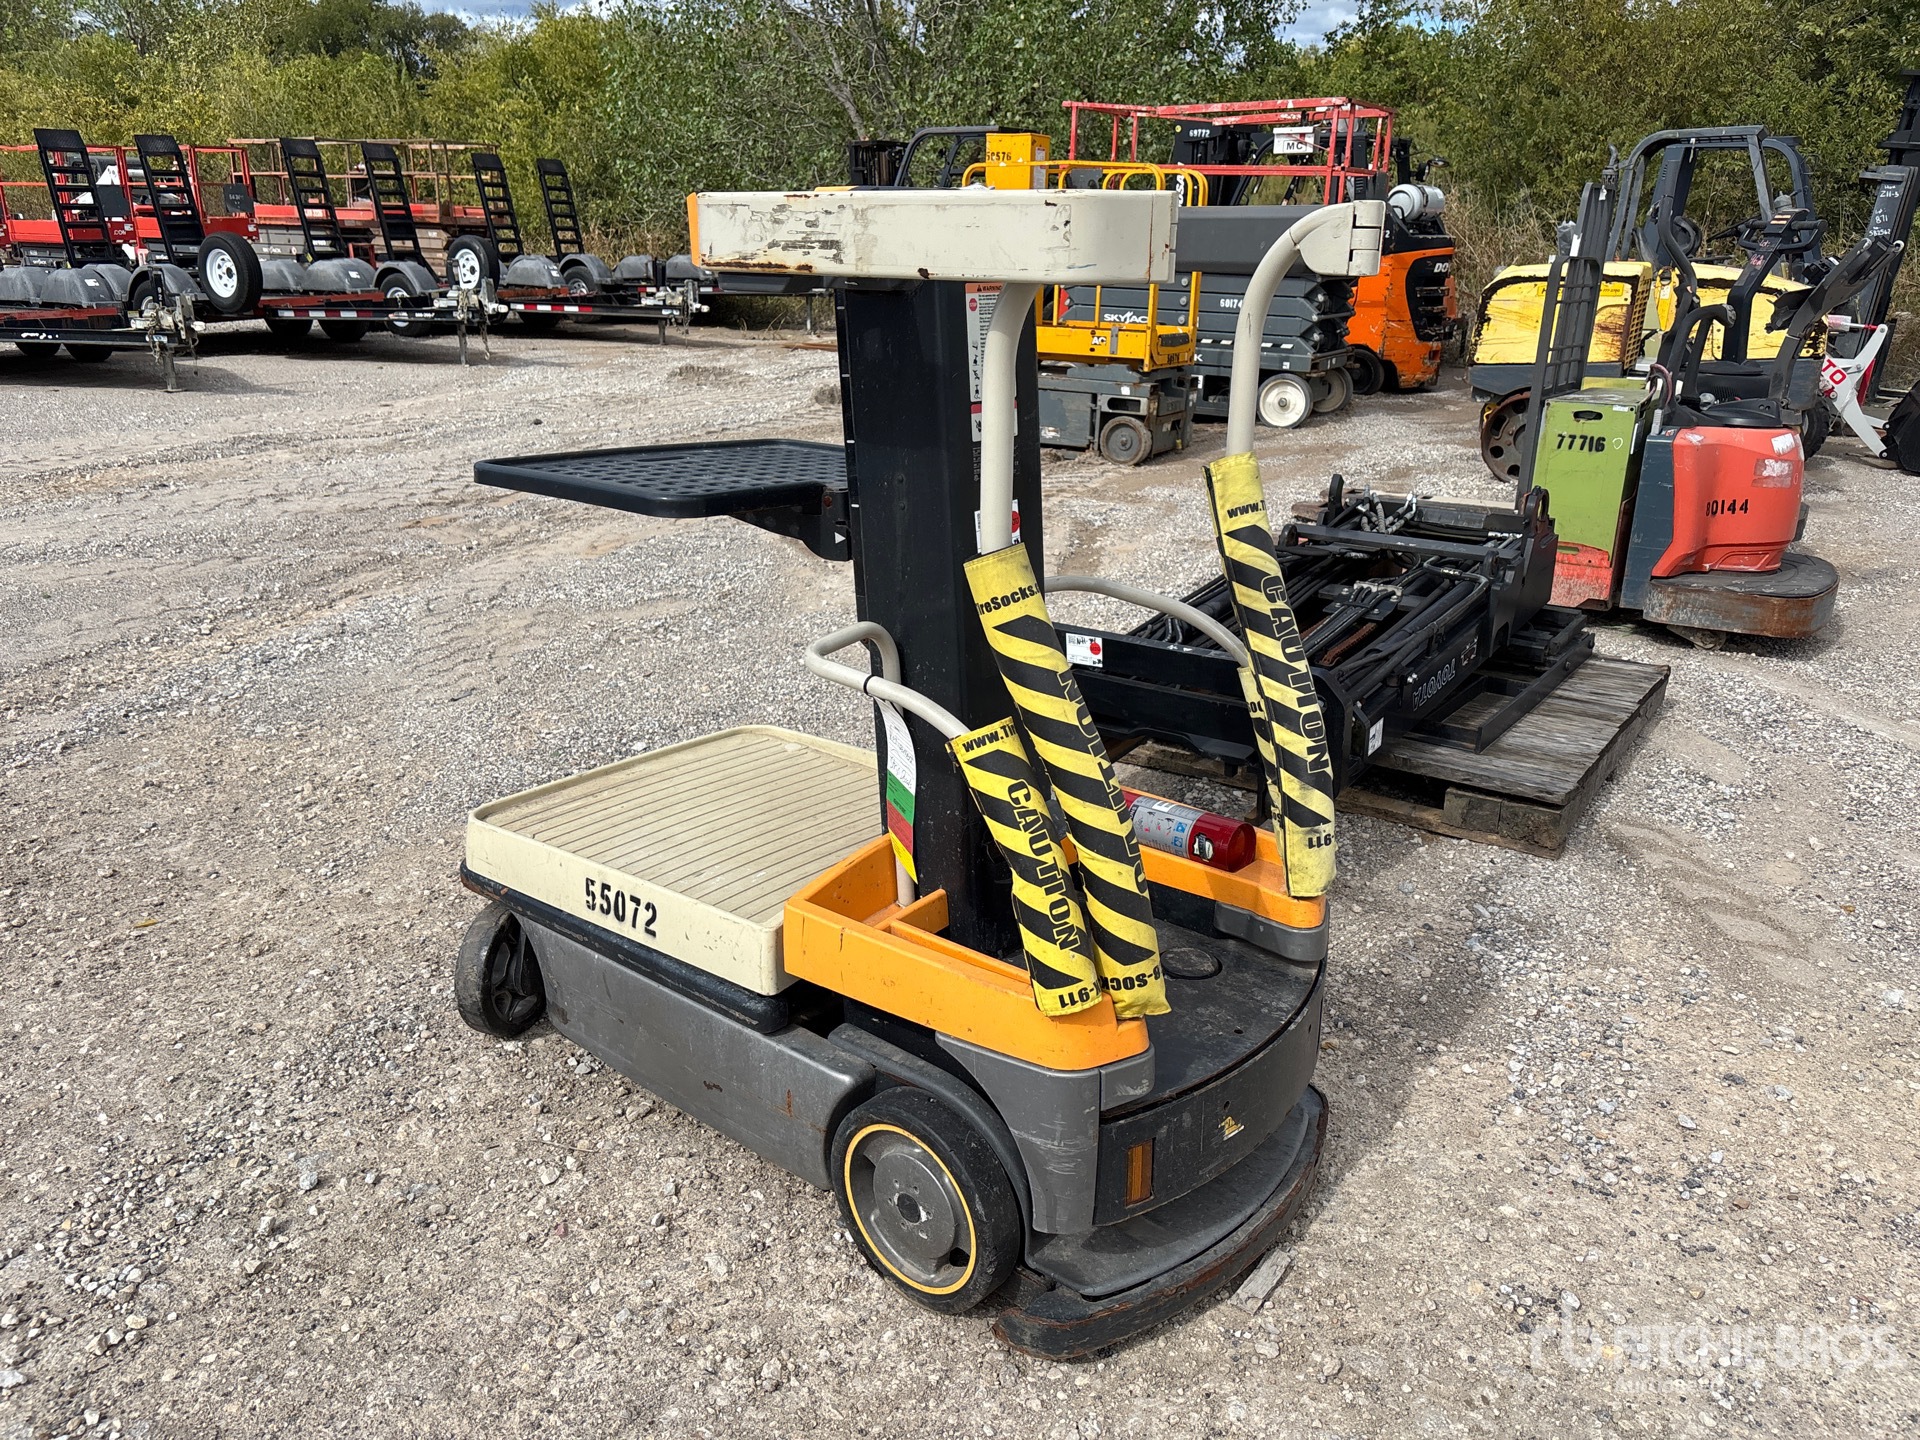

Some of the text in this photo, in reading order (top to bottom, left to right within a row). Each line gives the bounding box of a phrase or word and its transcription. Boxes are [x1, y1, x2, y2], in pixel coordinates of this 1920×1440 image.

[1189, 129, 1210, 138] 69772
[1286, 142, 1303, 150] MC
[1433, 262, 1449, 273] DO
[1103, 311, 1150, 324] SKYJAC
[1091, 336, 1107, 346] AC
[1557, 433, 1606, 453] 77716
[1706, 498, 1749, 517] 80144
[1261, 574, 1331, 774] CAUTION
[1412, 657, 1456, 712] TOYOTA
[1007, 779, 1083, 951] CAUTION
[585, 876, 658, 939] 55072
